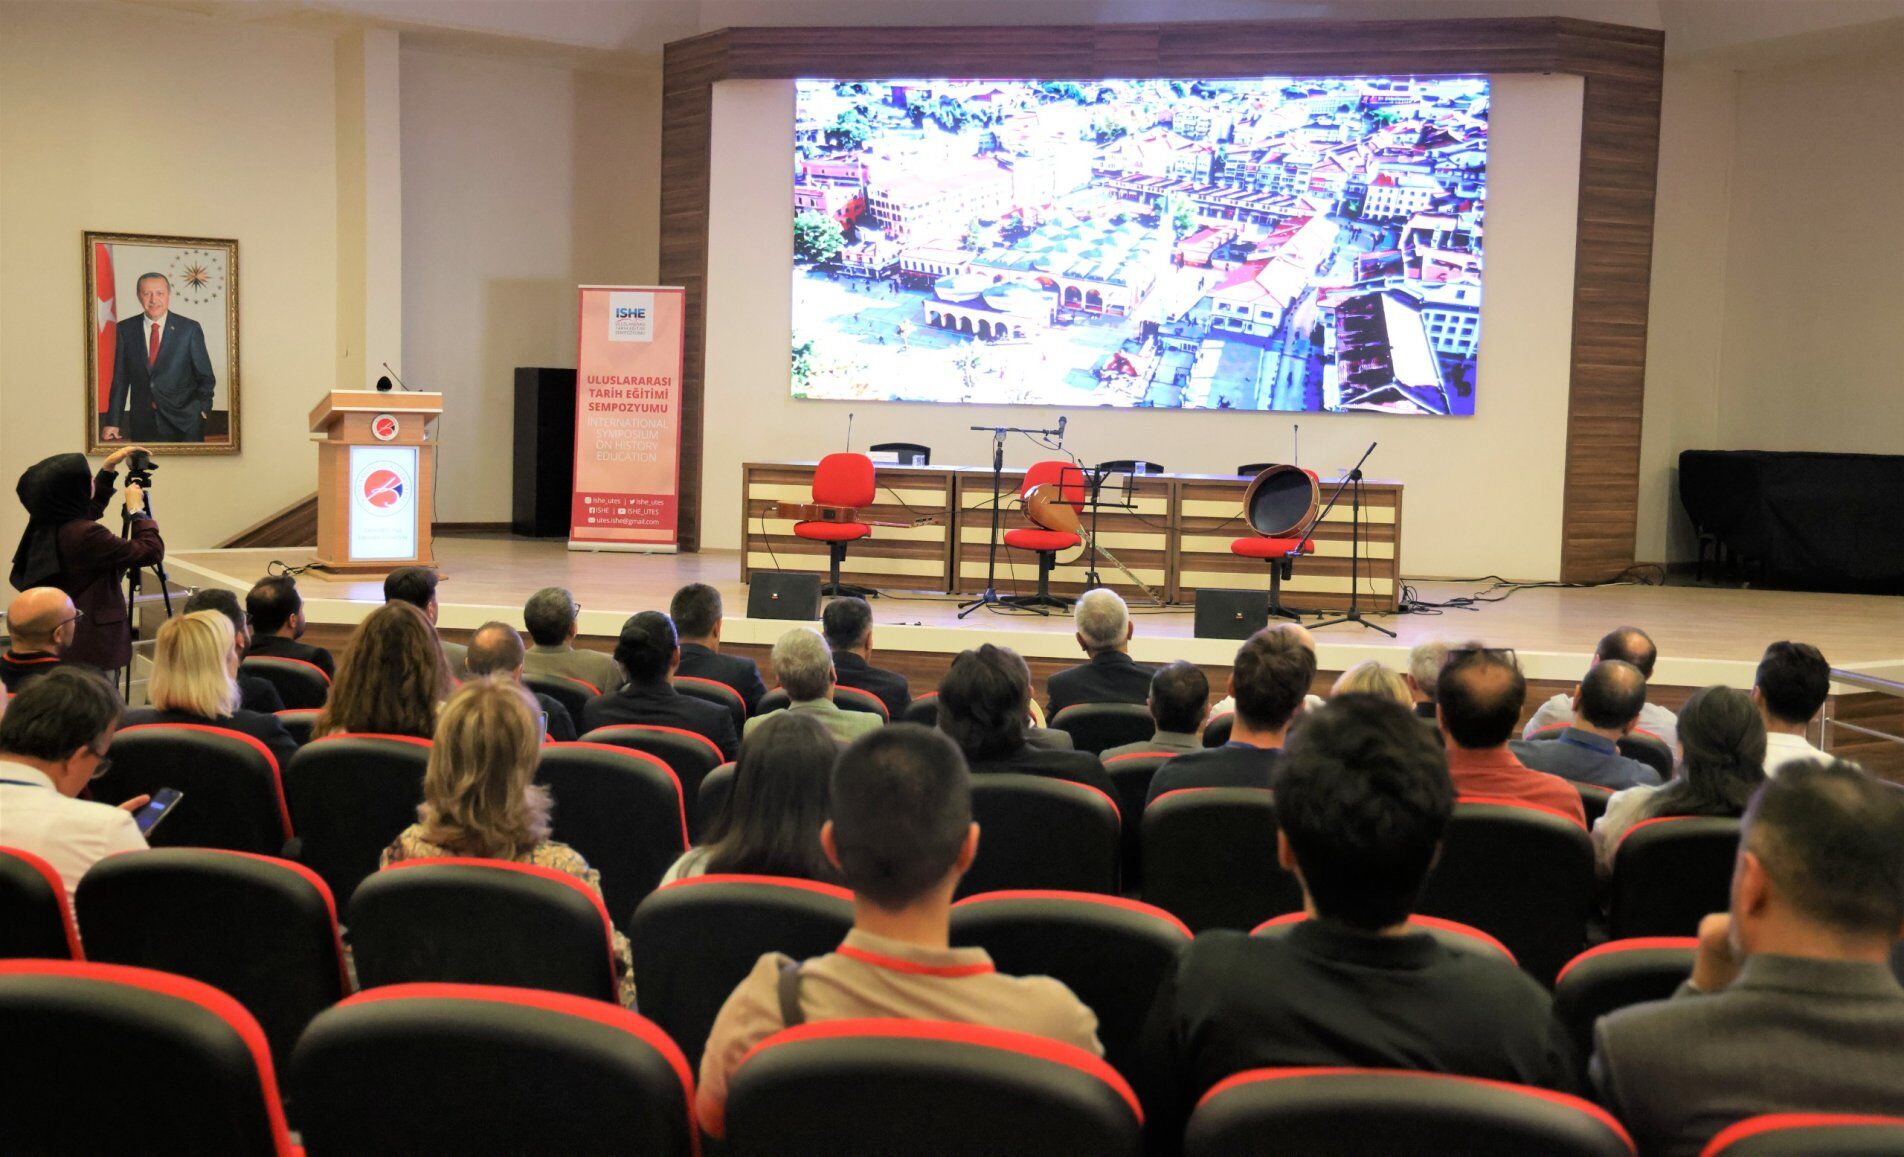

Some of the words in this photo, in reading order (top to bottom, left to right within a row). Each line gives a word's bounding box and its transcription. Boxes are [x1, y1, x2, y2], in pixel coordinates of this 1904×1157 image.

[616, 307, 646, 319] ISHE
[587, 375, 671, 386] ULUSLARARASI
[589, 387, 623, 399] TARİH
[626, 387, 669, 399] EĞİTİMİ
[588, 402, 668, 413] SEMPOZYUMU
[587, 417, 668, 429] INTERNATIONAL
[596, 429, 659, 440] SYMPOSIUM
[596, 440, 611, 450] ON
[615, 440, 658, 451] HISTORY
[596, 450, 657, 462] EDUCATION
